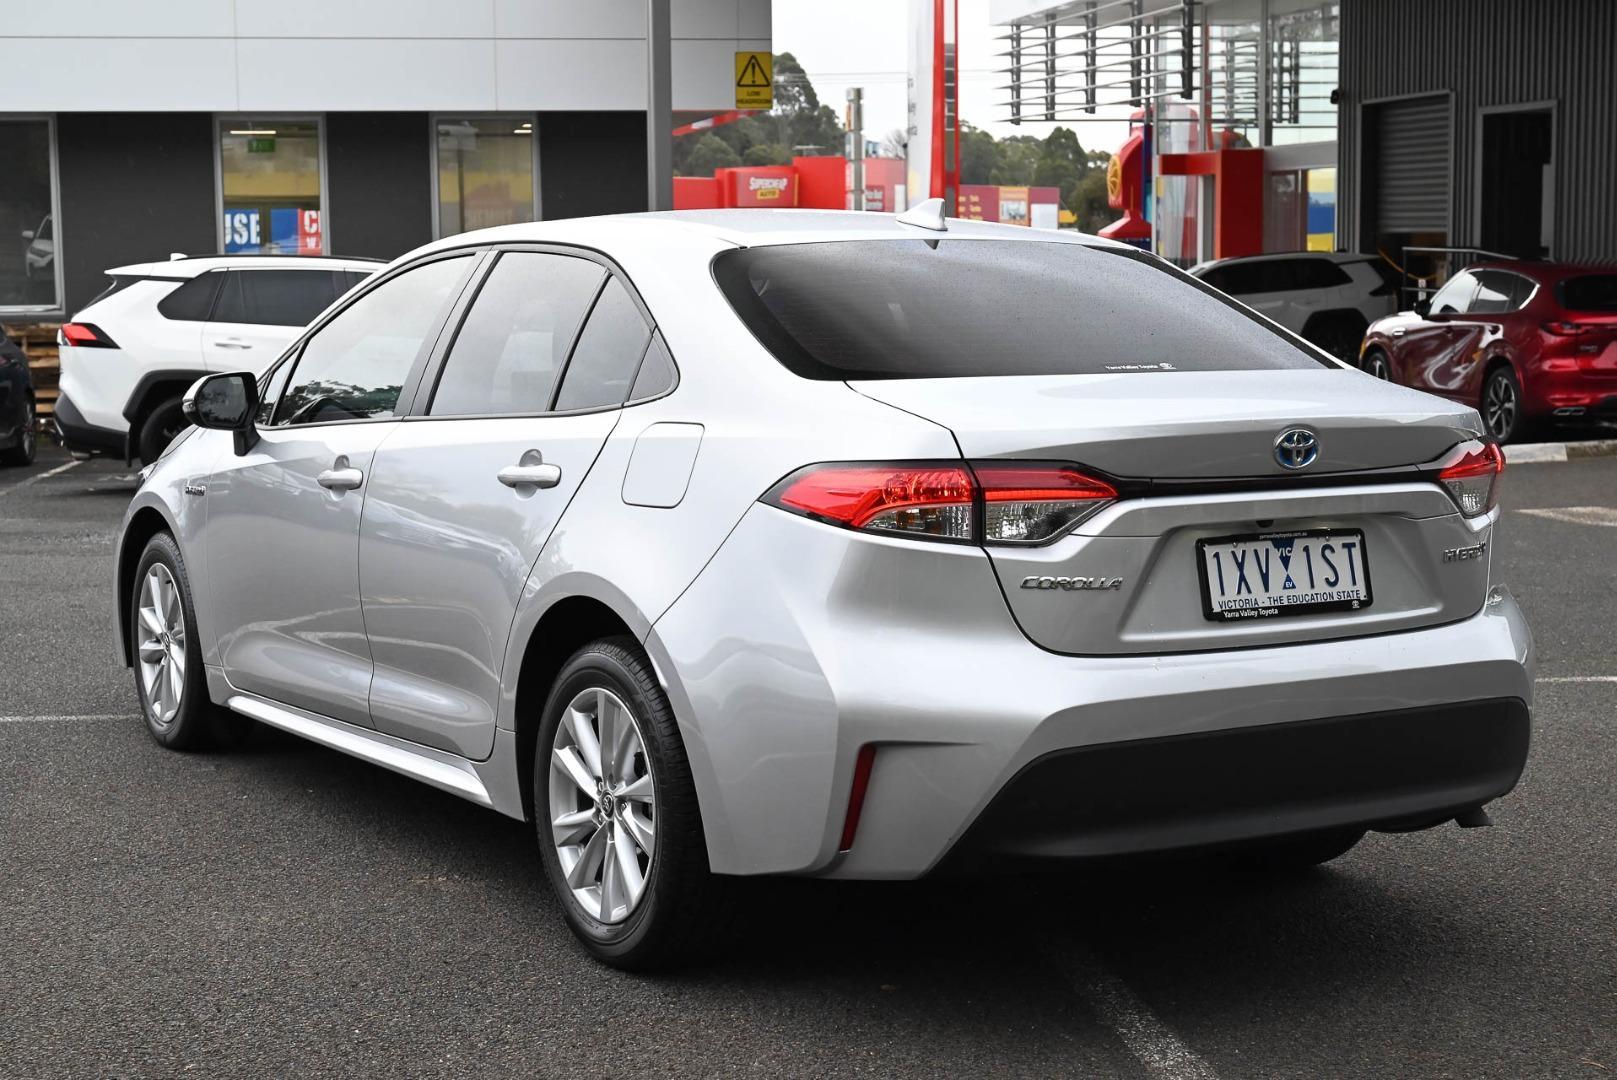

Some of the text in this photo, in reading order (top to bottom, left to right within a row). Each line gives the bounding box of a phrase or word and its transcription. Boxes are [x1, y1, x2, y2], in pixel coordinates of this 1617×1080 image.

[304, 210, 321, 234] C
[1020, 576, 1123, 591] COROLLA
[1218, 598, 1260, 610] VICTORIA
[1267, 596, 1285, 606] THE
[1286, 592, 1335, 604] EDUCATION
[1336, 589, 1361, 600] STATE
[1223, 608, 1279, 618] Yarra Valley Toyota
